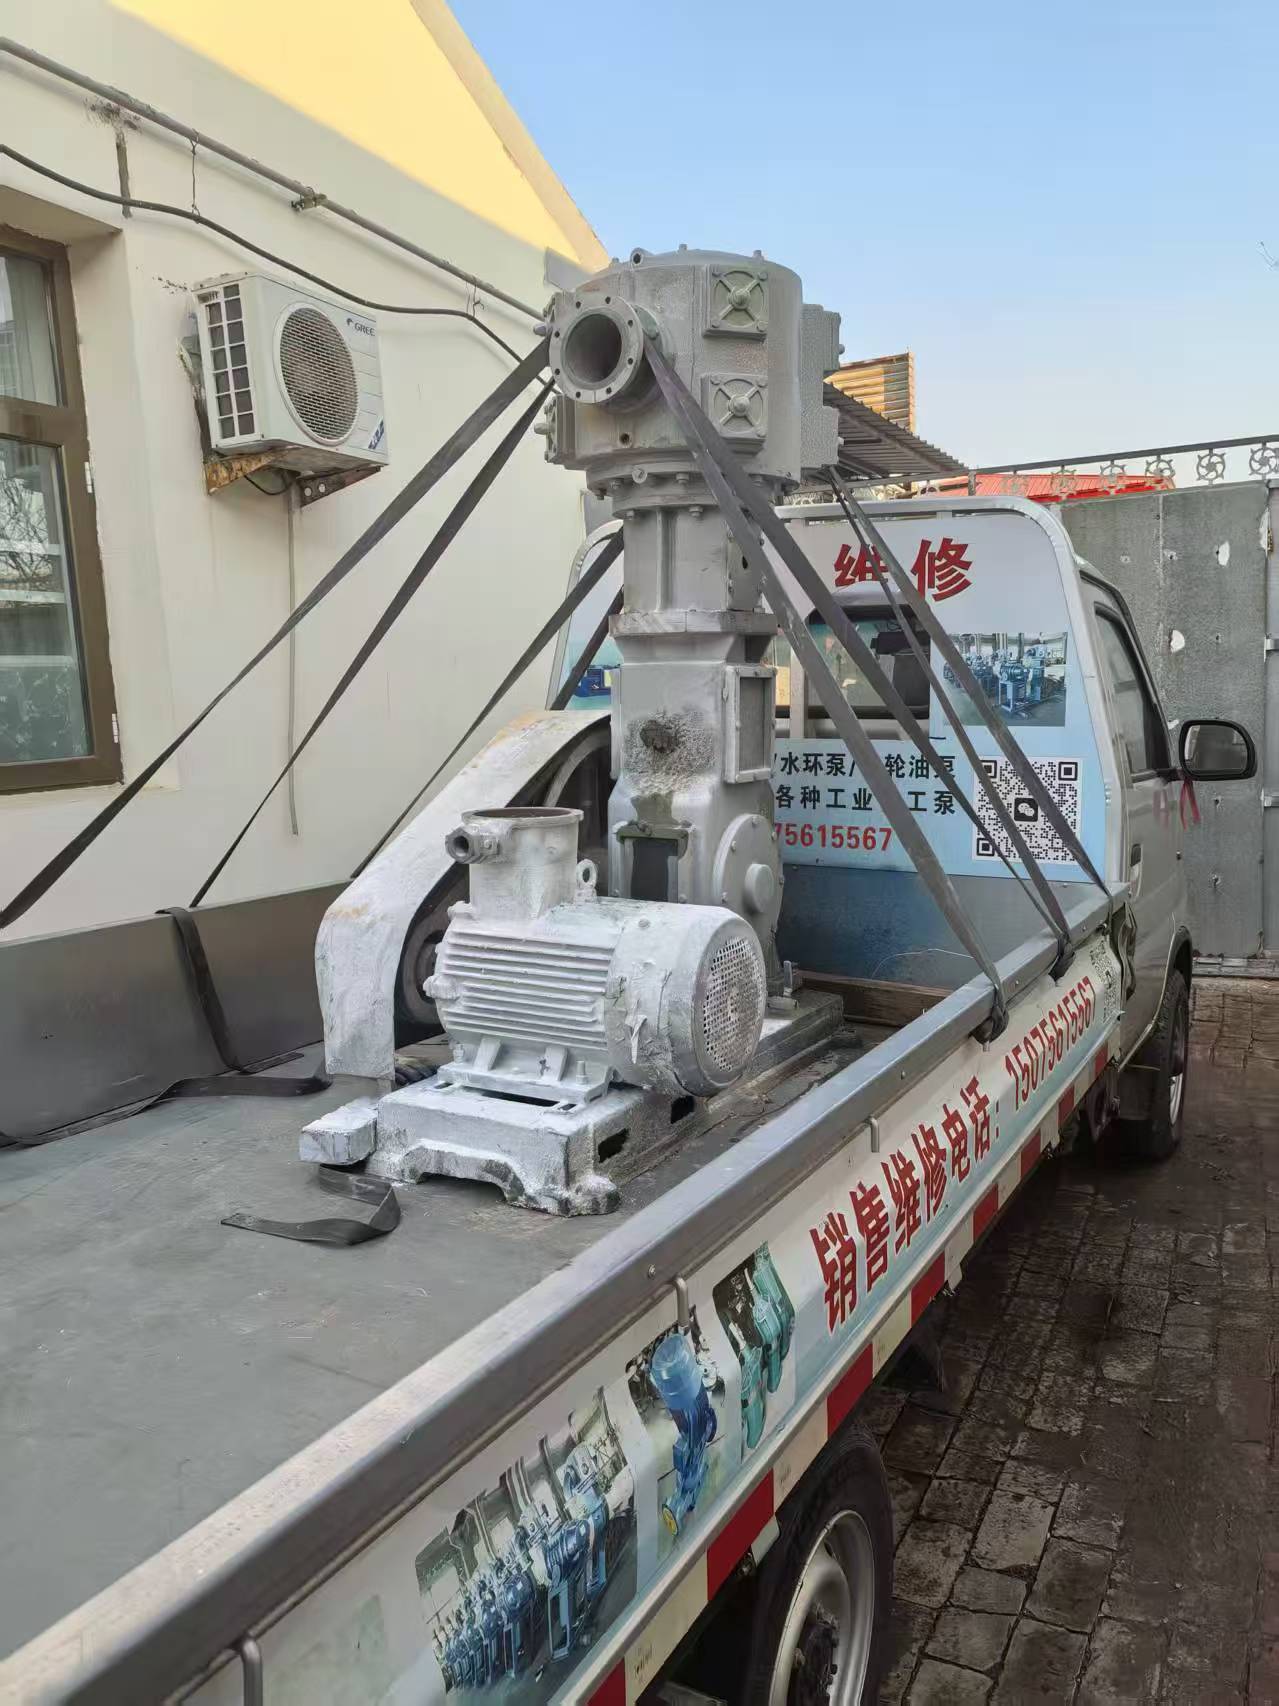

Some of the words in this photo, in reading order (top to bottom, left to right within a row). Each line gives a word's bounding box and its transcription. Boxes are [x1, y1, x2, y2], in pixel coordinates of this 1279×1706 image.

[354, 322, 376, 337] GREE
[834, 537, 972, 602] 维修
[776, 784, 956, 815] 各种工业工泵
[1005, 976, 1096, 1111] 15075615567
